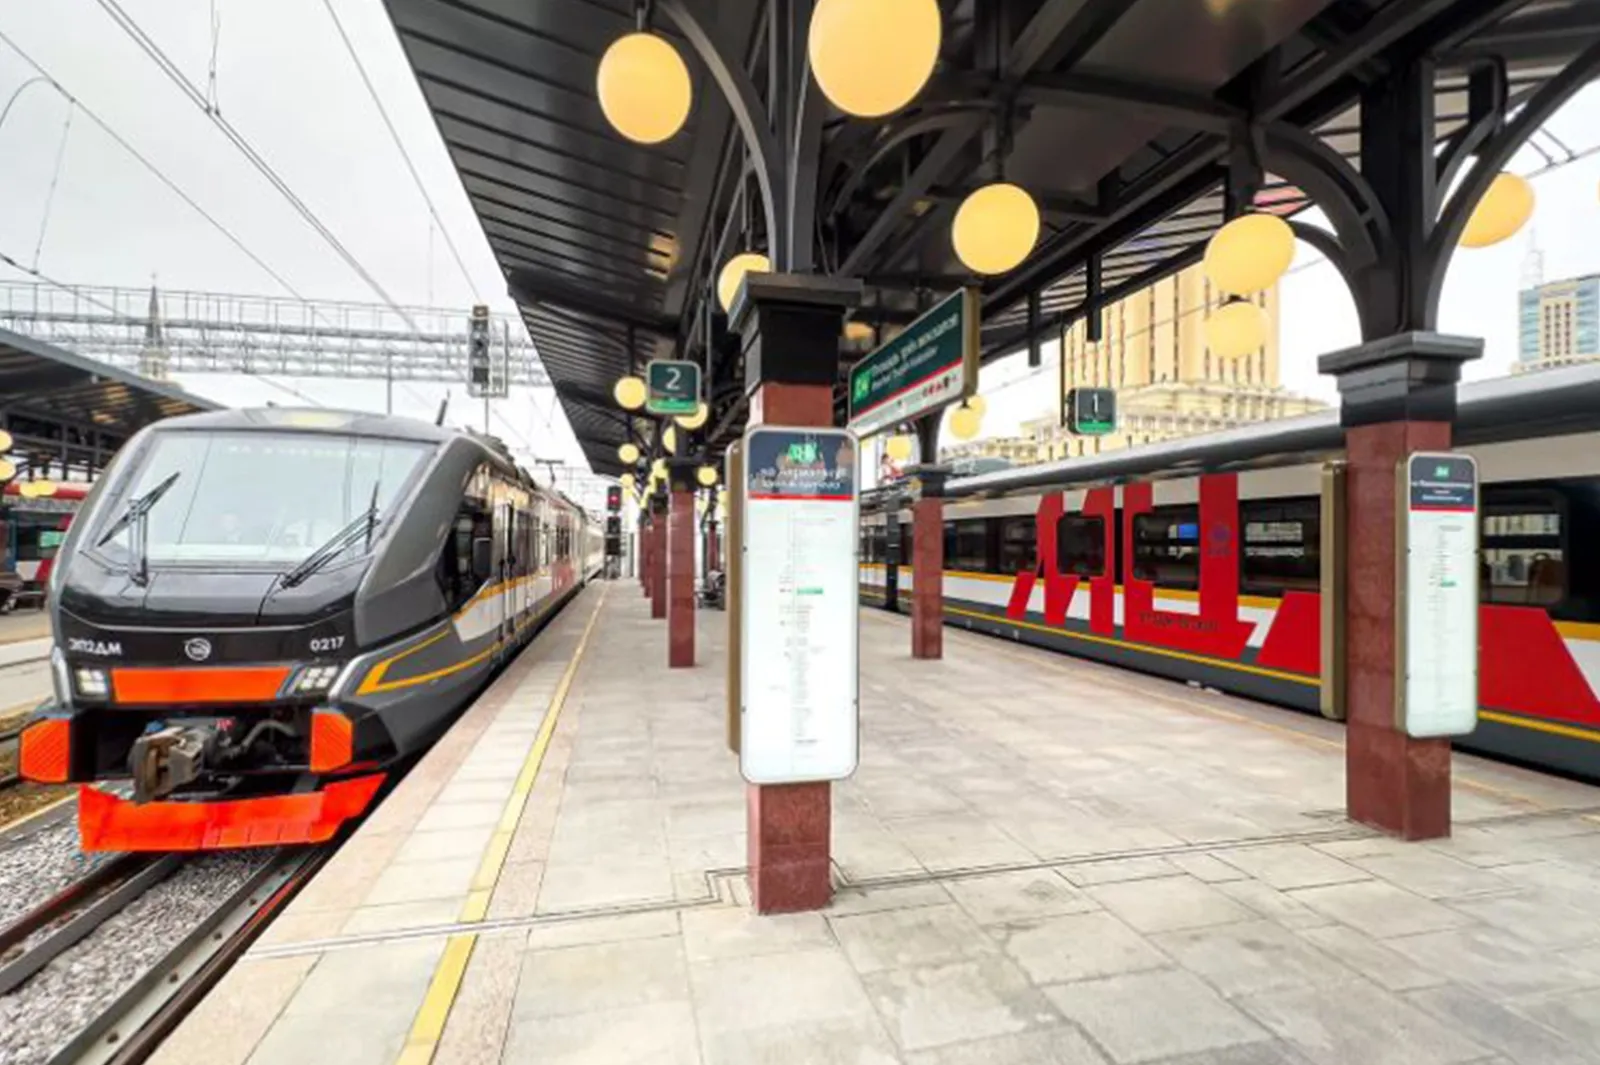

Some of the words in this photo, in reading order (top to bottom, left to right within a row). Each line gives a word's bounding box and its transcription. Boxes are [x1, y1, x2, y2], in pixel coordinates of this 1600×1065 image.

[665, 366, 682, 391] 2
[1092, 392, 1099, 414] 1
[309, 636, 346, 651] 0217
